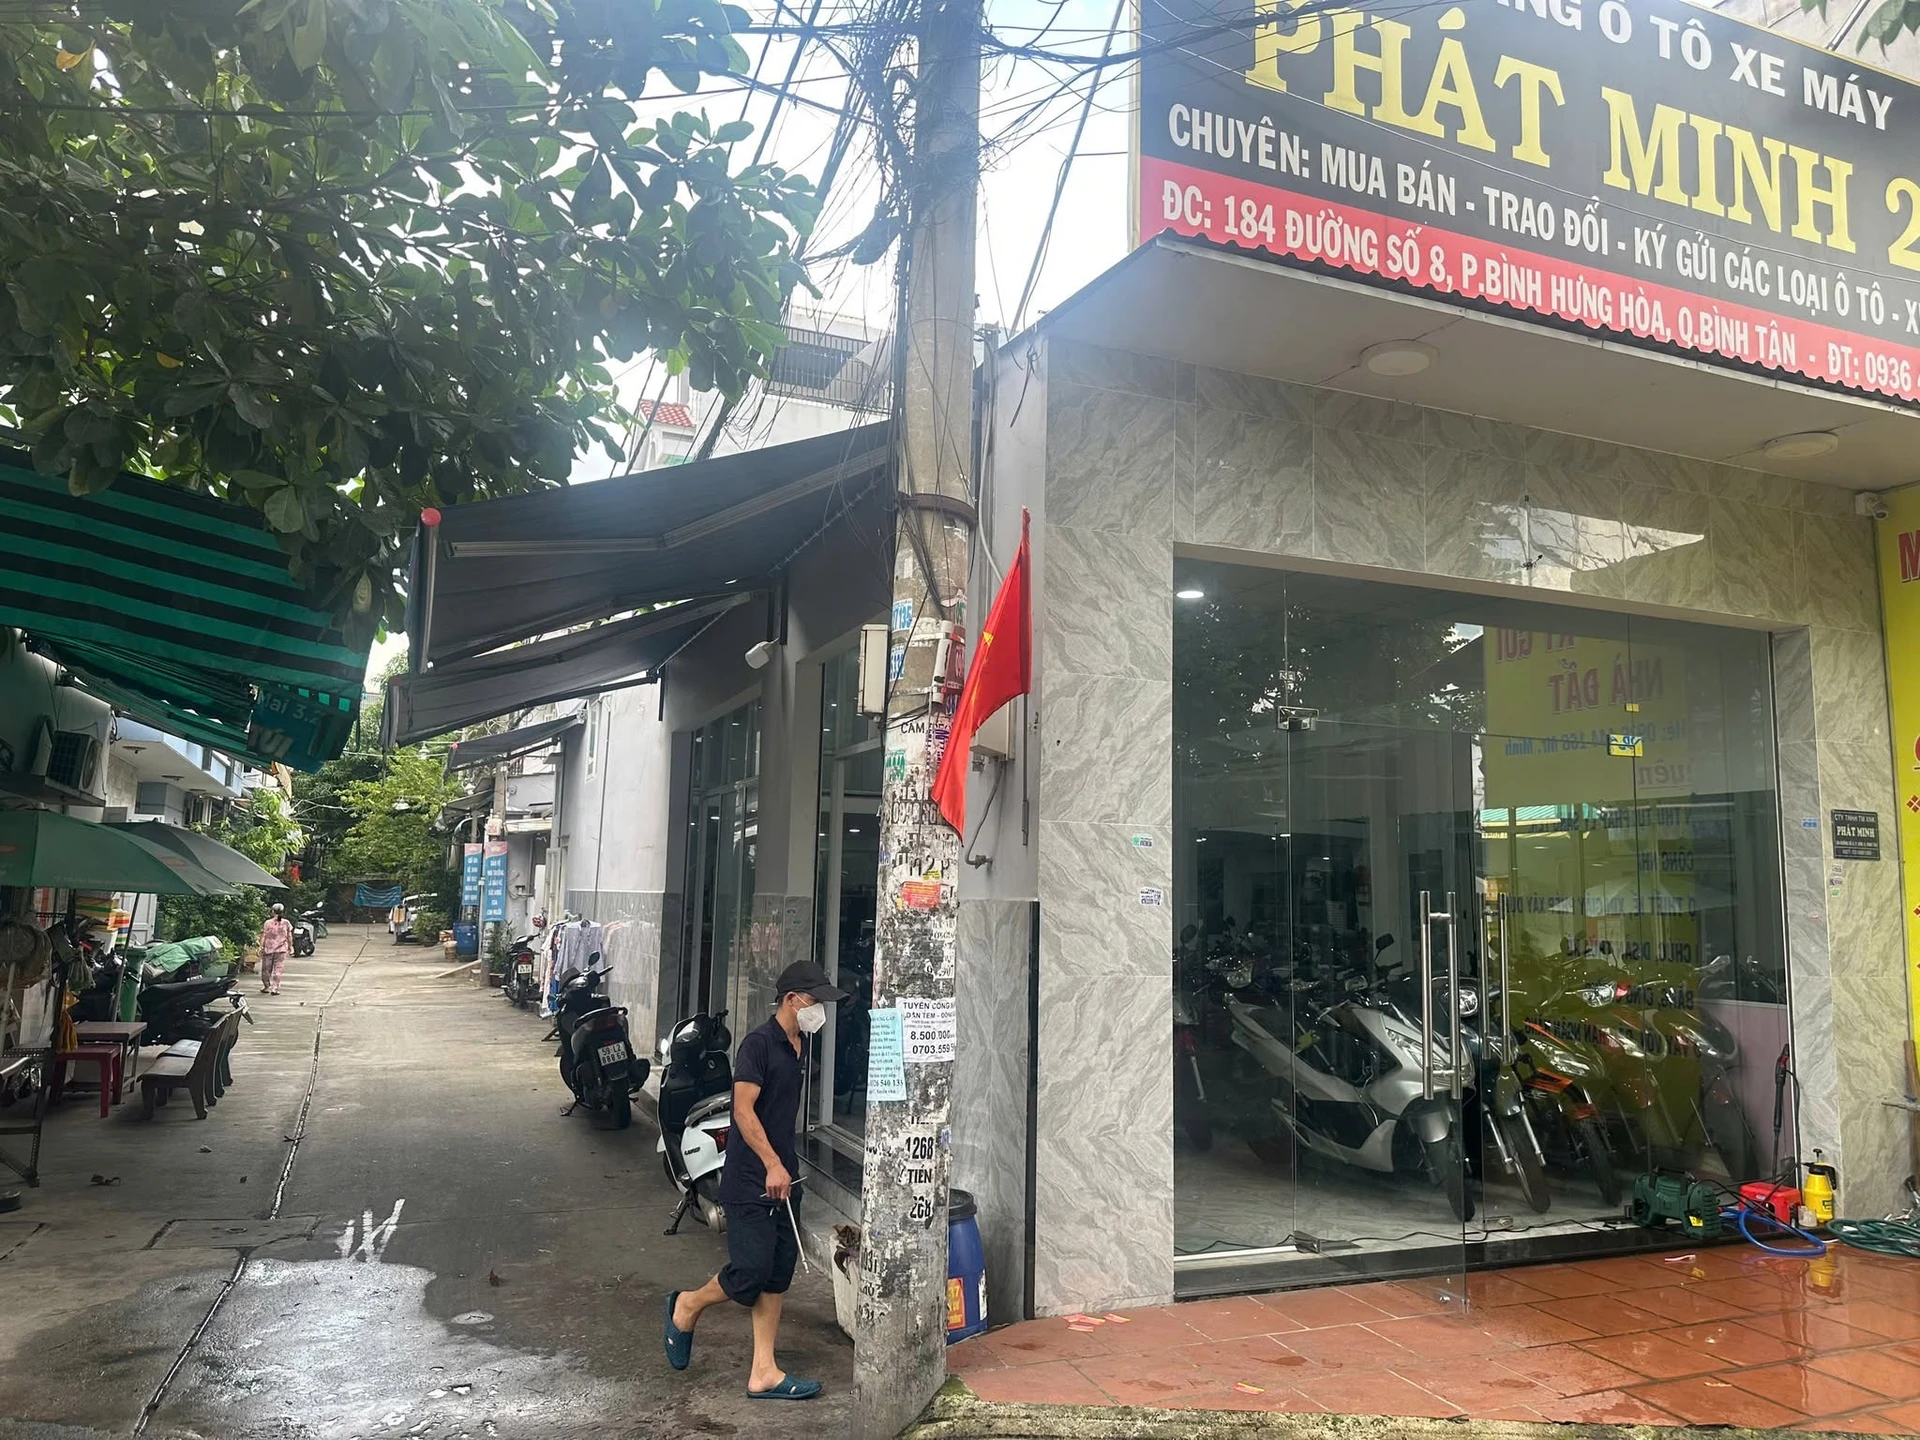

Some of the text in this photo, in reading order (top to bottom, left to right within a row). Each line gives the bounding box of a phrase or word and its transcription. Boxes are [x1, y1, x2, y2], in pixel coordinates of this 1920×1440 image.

[1245, 0, 1566, 168] PHÁT
[1601, 86, 1857, 255] MINH
[1650, 15, 1712, 70] TÔ
[1730, 42, 1786, 97] XE
[1803, 68, 1892, 131] MÁY
[1162, 180, 1212, 229] ĐC:
[1224, 195, 1276, 243] 184
[1285, 207, 1379, 269] ĐƯỜNG
[1385, 226, 1422, 277] SỐ
[1428, 245, 1453, 293] 8,
[1461, 252, 1542, 308] P.BÌNH
[1550, 273, 1613, 325] HƯNG
[1620, 286, 1672, 343] HÒA,
[1678, 305, 1750, 355] Q.BÌNH
[1754, 320, 1797, 367] TÂN
[1828, 342, 1860, 381] ĐT:
[1865, 351, 1912, 392] 0936
[1168, 103, 1310, 179] CHUYÊN:
[1321, 142, 1387, 198] MUA
[1396, 160, 1456, 216] BÁN
[1482, 186, 1555, 241] TRAO
[1563, 196, 1608, 255] ĐỔI
[1634, 223, 1667, 269] KÝ
[1675, 231, 1717, 283] GỬI
[1723, 247, 1770, 297] CÁC
[1777, 265, 1828, 316] LOẠI
[1834, 272, 1850, 317] Ô
[1855, 281, 1885, 325] TÔ
[1905, 299, 1920, 335] X
[905, 1136, 934, 1160] 1268
